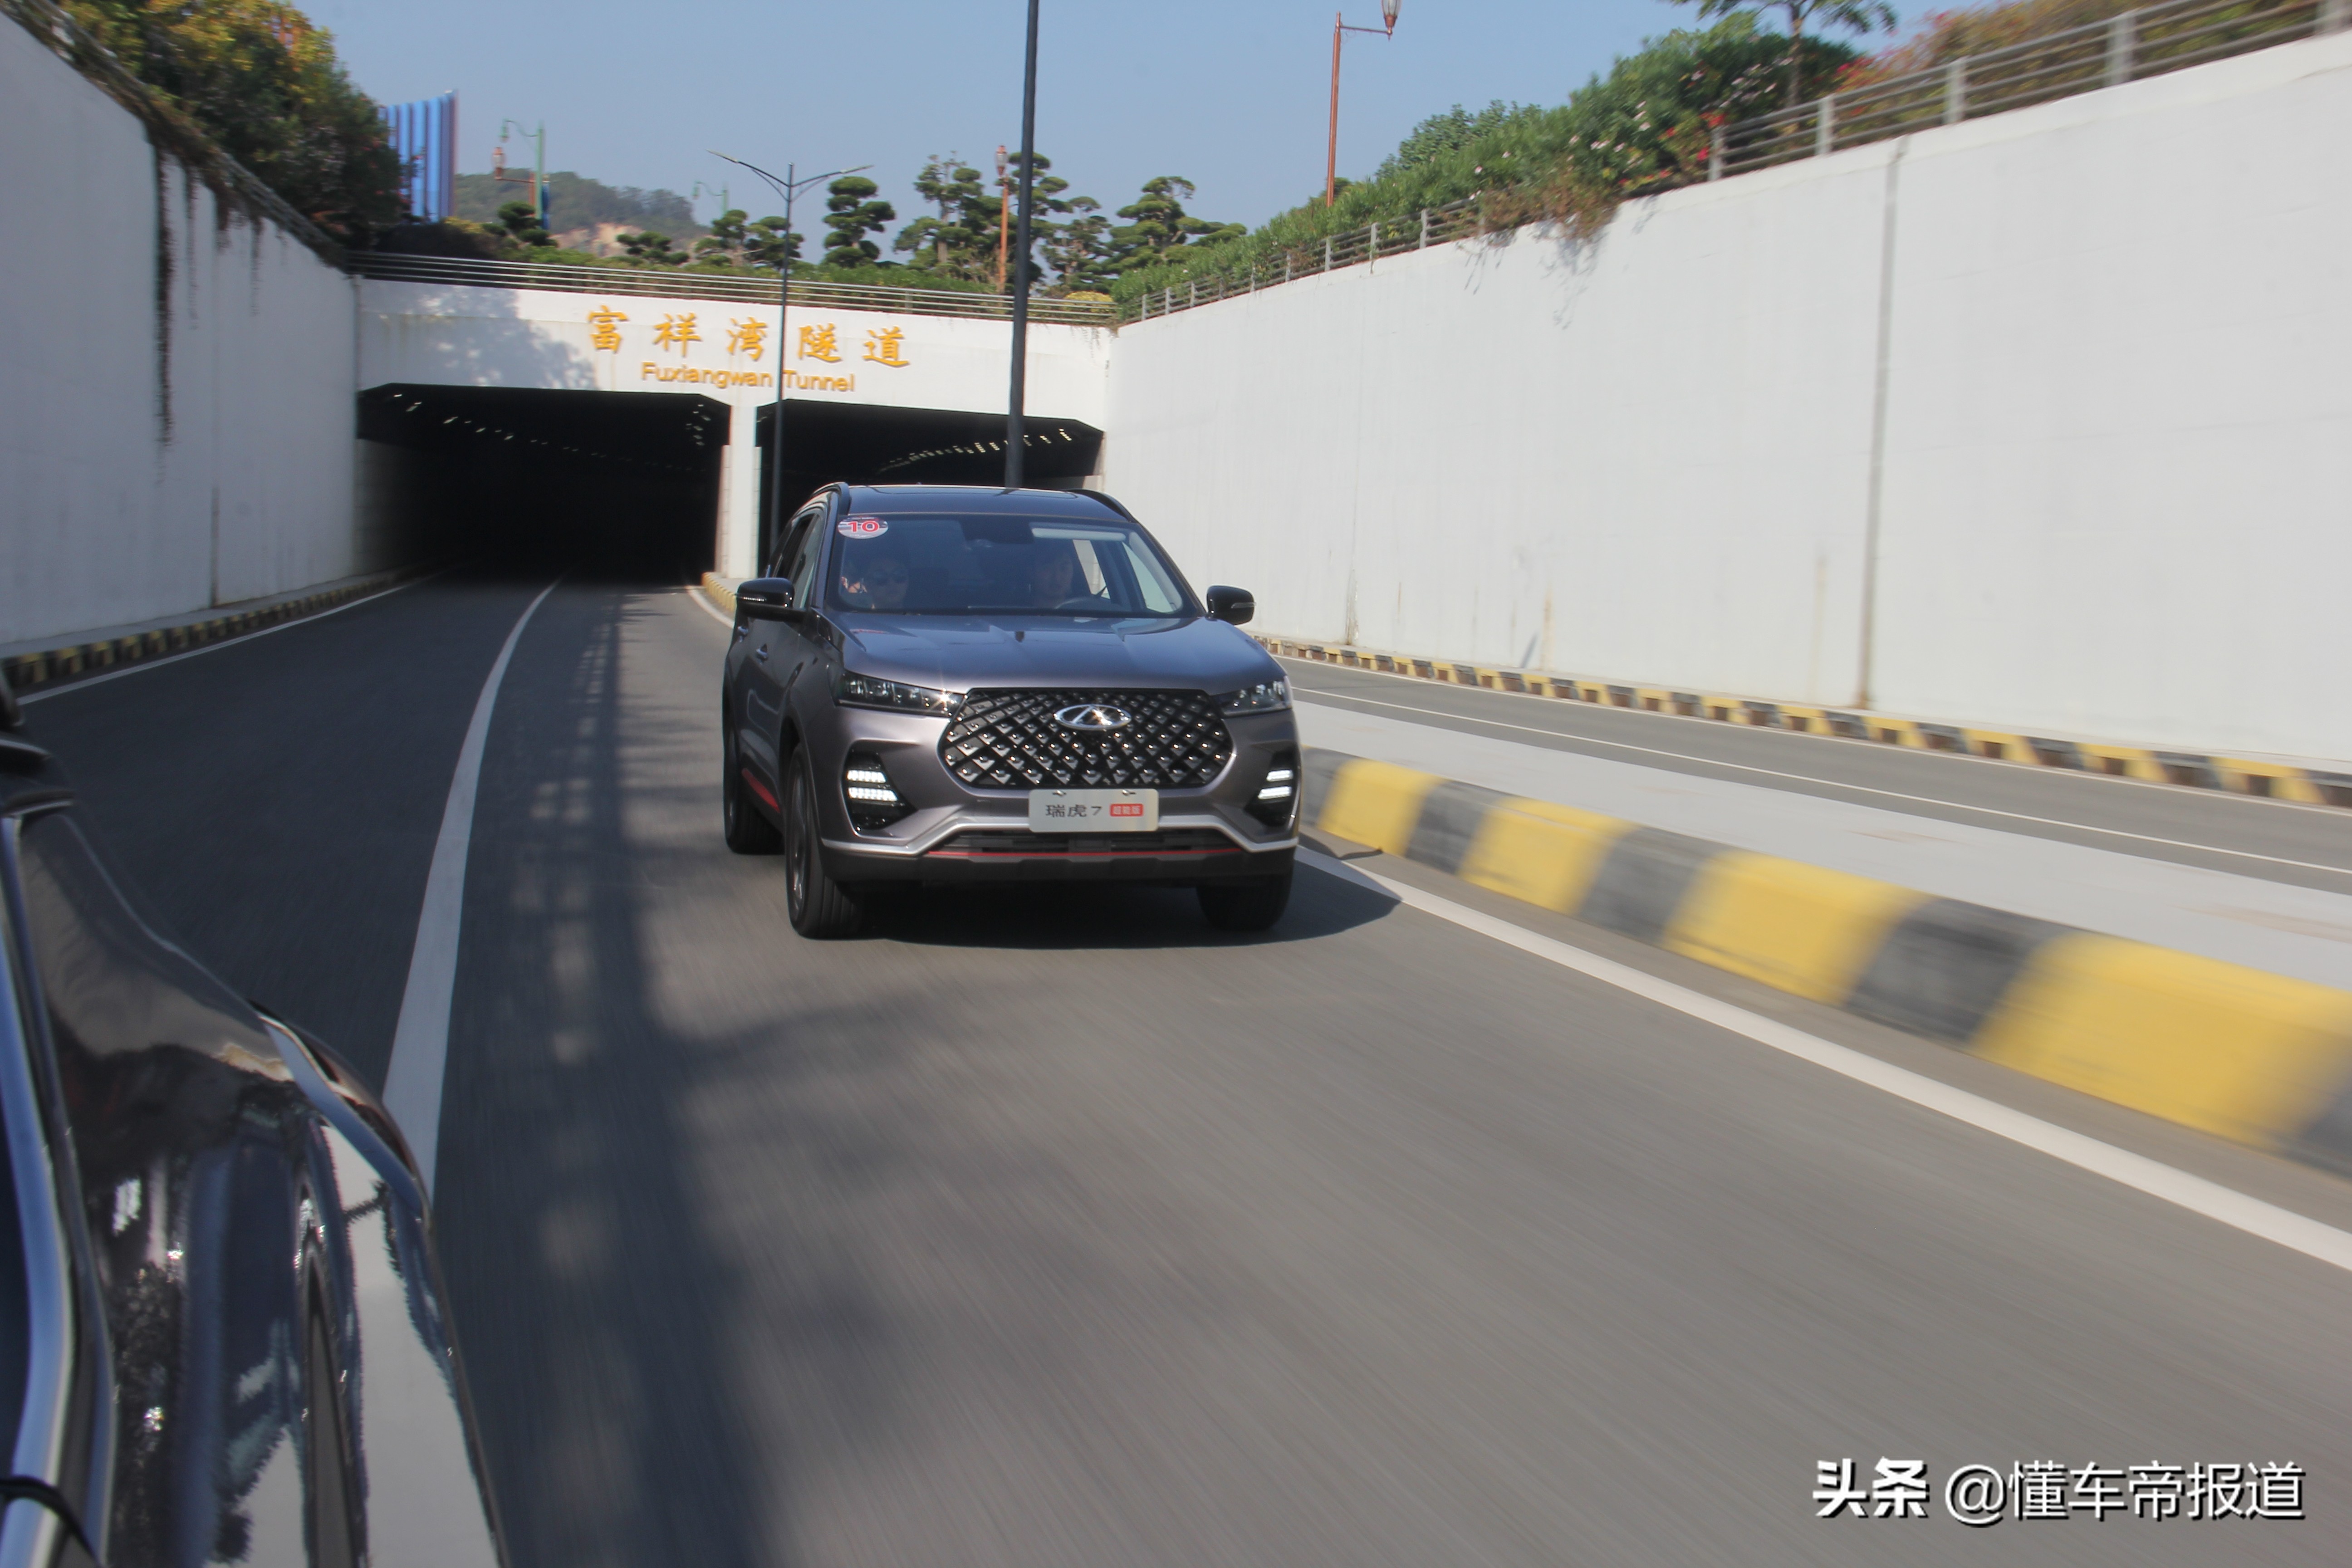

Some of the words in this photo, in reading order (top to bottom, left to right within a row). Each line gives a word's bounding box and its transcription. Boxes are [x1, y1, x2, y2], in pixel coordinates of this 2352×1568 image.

[587, 305, 910, 368] 富祥湾隧道
[642, 362, 773, 389] Fuxiangwan
[782, 368, 855, 392] Tunnel
[847, 520, 880, 533] 10
